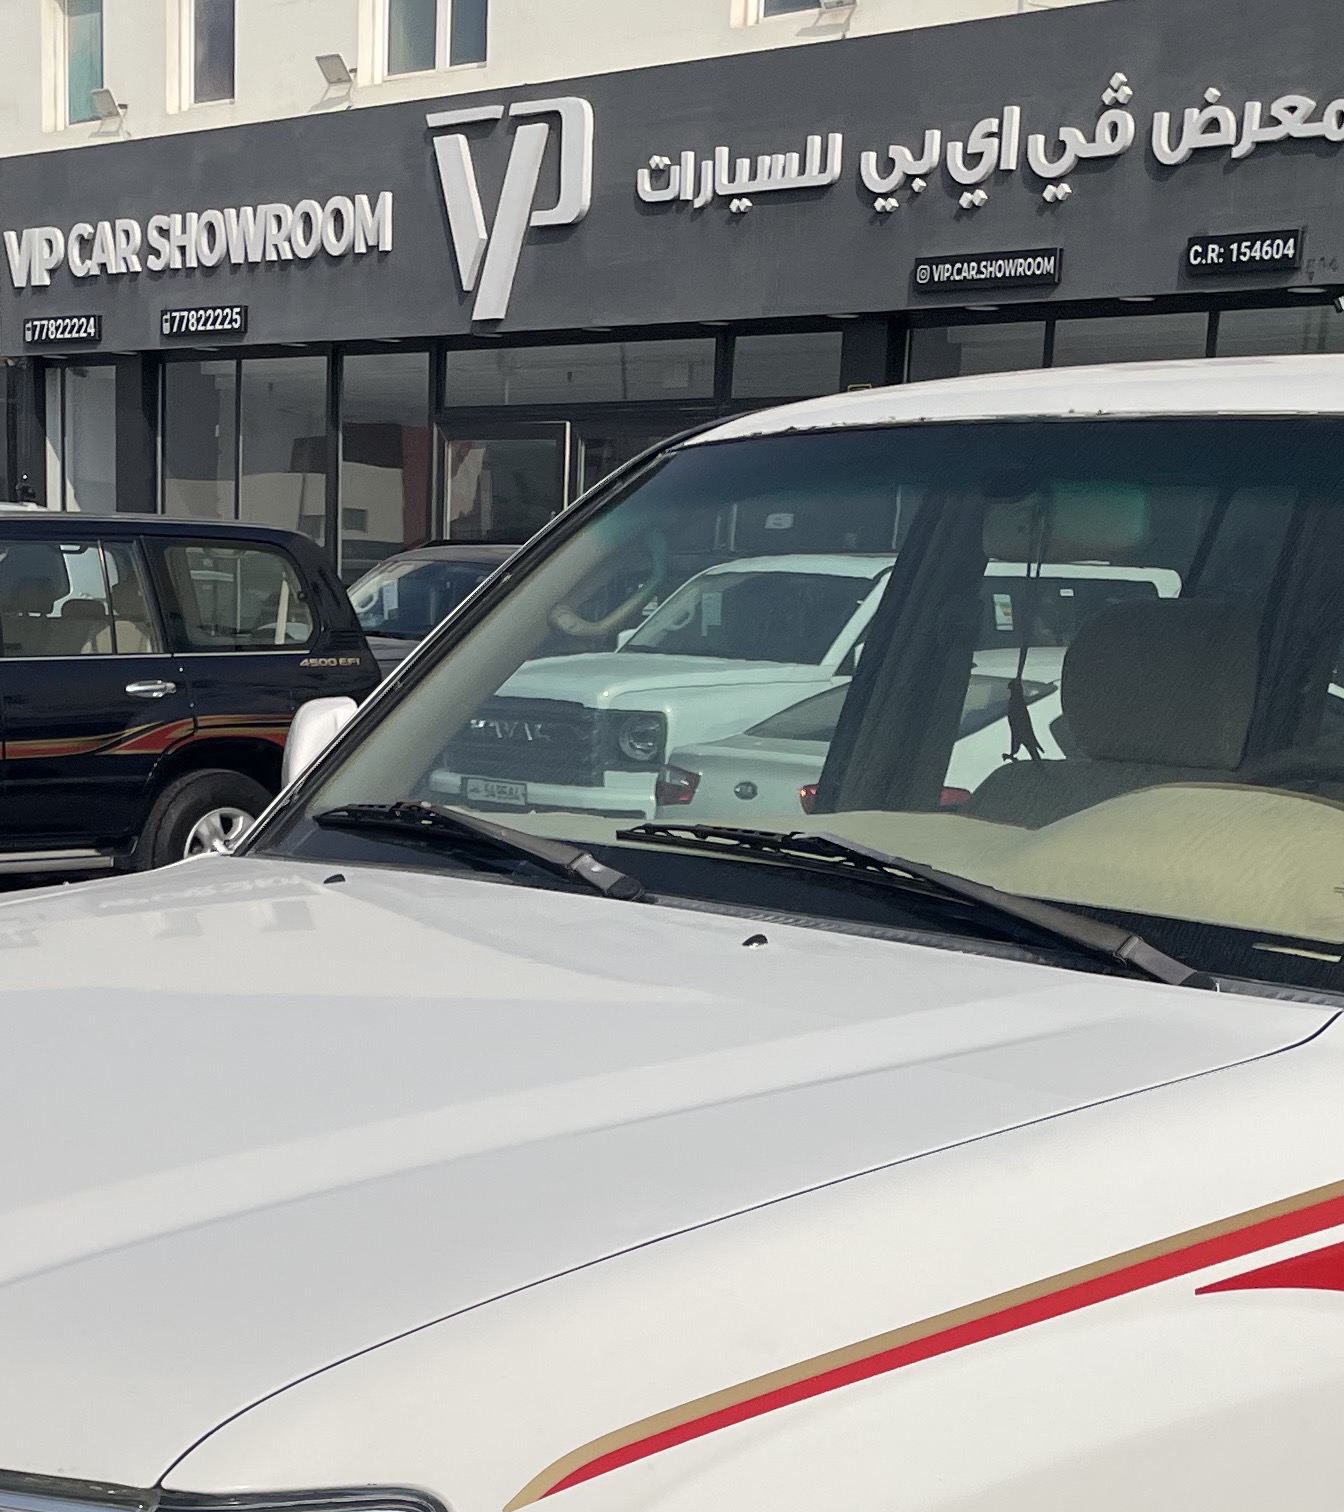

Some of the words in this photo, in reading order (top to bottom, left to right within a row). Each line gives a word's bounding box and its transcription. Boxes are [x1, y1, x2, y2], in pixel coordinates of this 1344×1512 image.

[637, 131, 844, 213] للسيارات
[860, 128, 942, 212] بي
[3, 226, 65, 288] VIP
[67, 218, 142, 278] CAR
[146, 191, 393, 272] SHOWROOM
[1229, 238, 1295, 263] 154604
[32, 316, 95, 341] 77822224
[171, 307, 241, 333] 77822225
